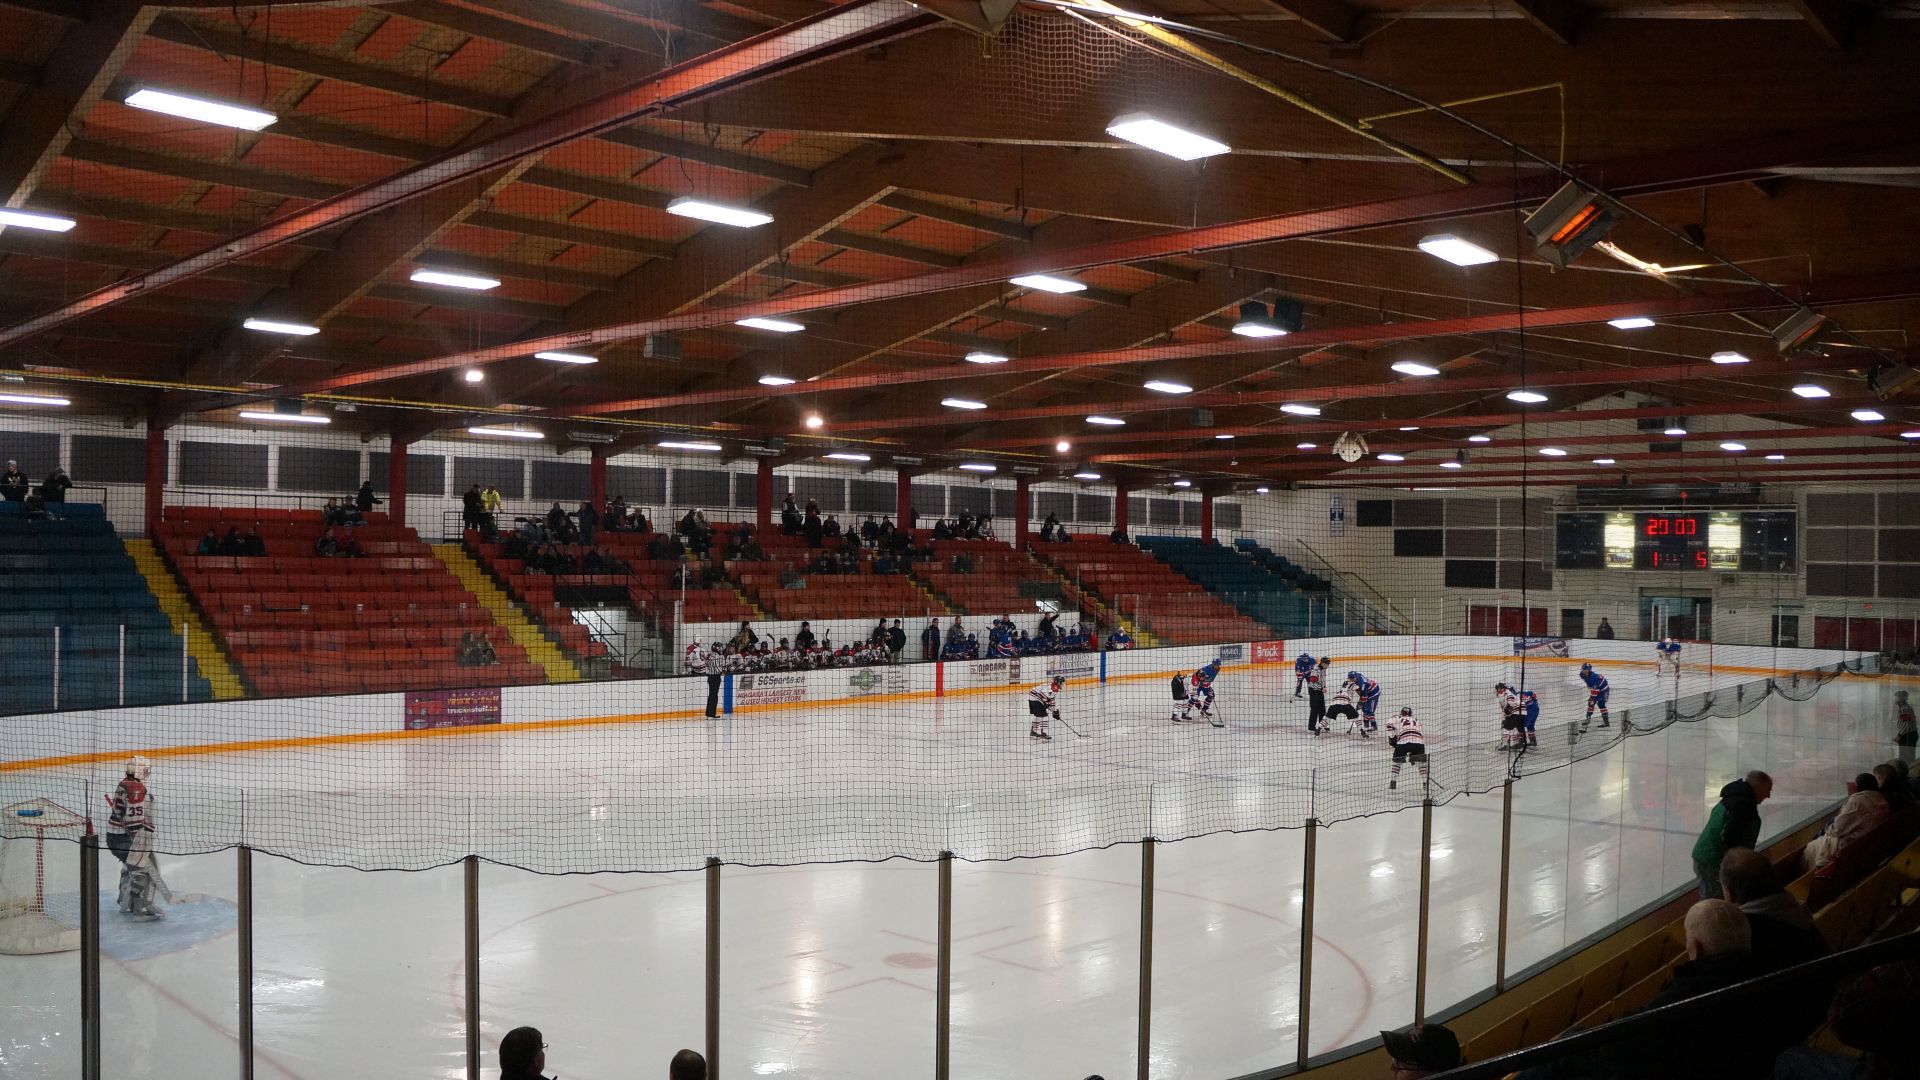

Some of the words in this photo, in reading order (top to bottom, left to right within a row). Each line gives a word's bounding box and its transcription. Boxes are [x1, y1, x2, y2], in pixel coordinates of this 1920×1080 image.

[1696, 551, 1707, 568] 5
[1257, 645, 1279, 657] Brock
[128, 806, 143, 817] 35
